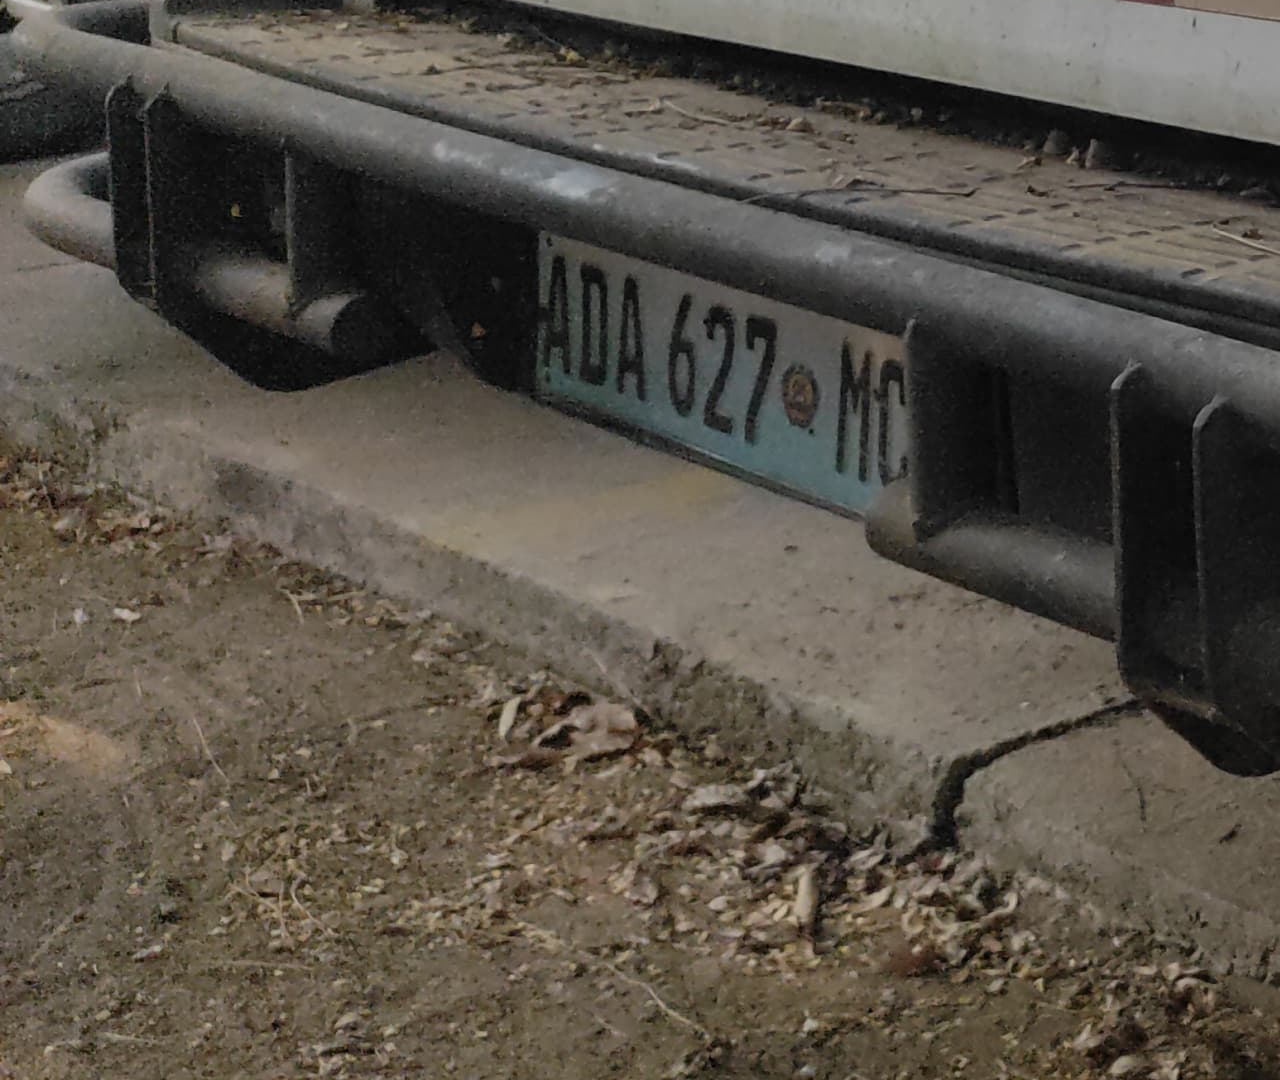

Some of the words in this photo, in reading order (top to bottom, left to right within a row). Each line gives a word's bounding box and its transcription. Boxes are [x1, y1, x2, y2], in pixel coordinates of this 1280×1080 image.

[541, 255, 647, 402] ADA
[667, 292, 779, 446] 627
[835, 335, 909, 487] MC
